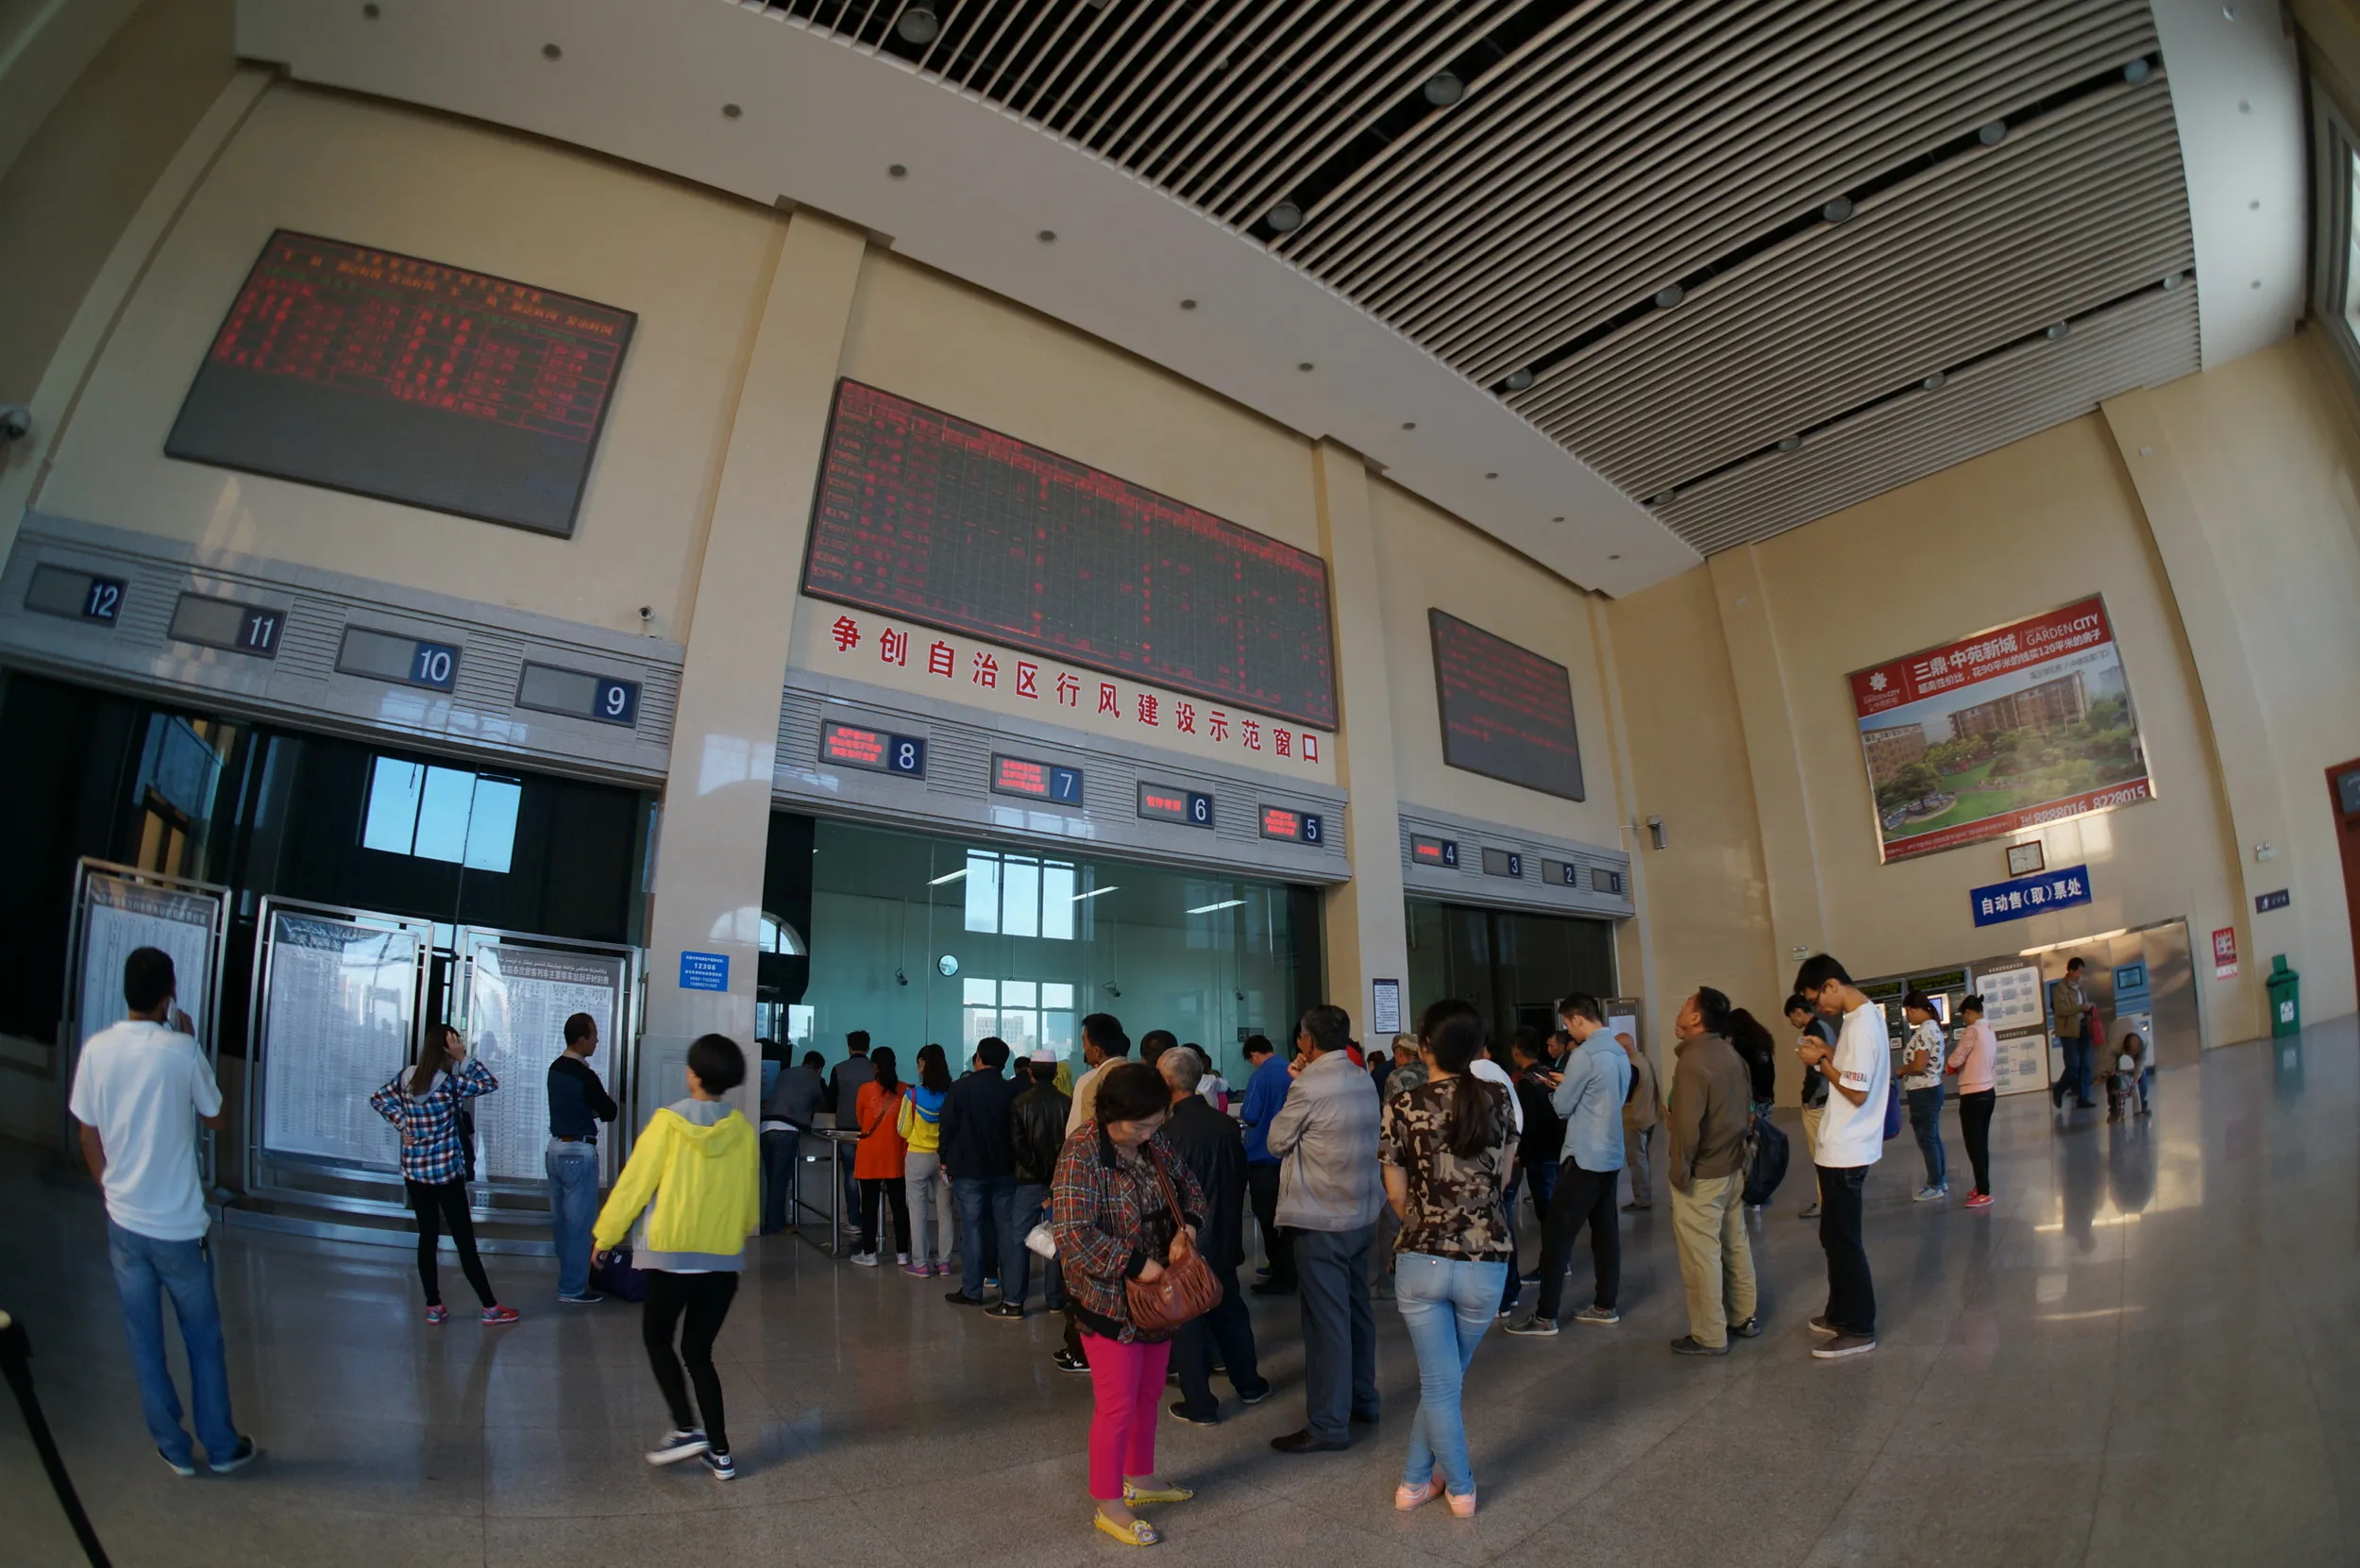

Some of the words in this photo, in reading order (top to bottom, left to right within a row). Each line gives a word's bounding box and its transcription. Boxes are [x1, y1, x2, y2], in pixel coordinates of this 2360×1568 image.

[91, 582, 119, 618] 12
[249, 615, 275, 649] 11
[2026, 622, 2073, 647] GARDEN
[2073, 613, 2099, 631] CITY
[421, 649, 452, 682] 10
[606, 686, 626, 716] 9
[832, 615, 1319, 764] 争创自治区行风建设示范窗口
[899, 742, 915, 770] 8
[1060, 772, 1073, 798] 7
[2092, 785, 2147, 811] 8228015
[1194, 798, 1206, 821] 6
[1306, 818, 1317, 839] 5
[1445, 845, 1455, 863] 4
[1511, 856, 1519, 874] 3
[1565, 867, 1574, 884] 2
[1612, 876, 1618, 889] 1
